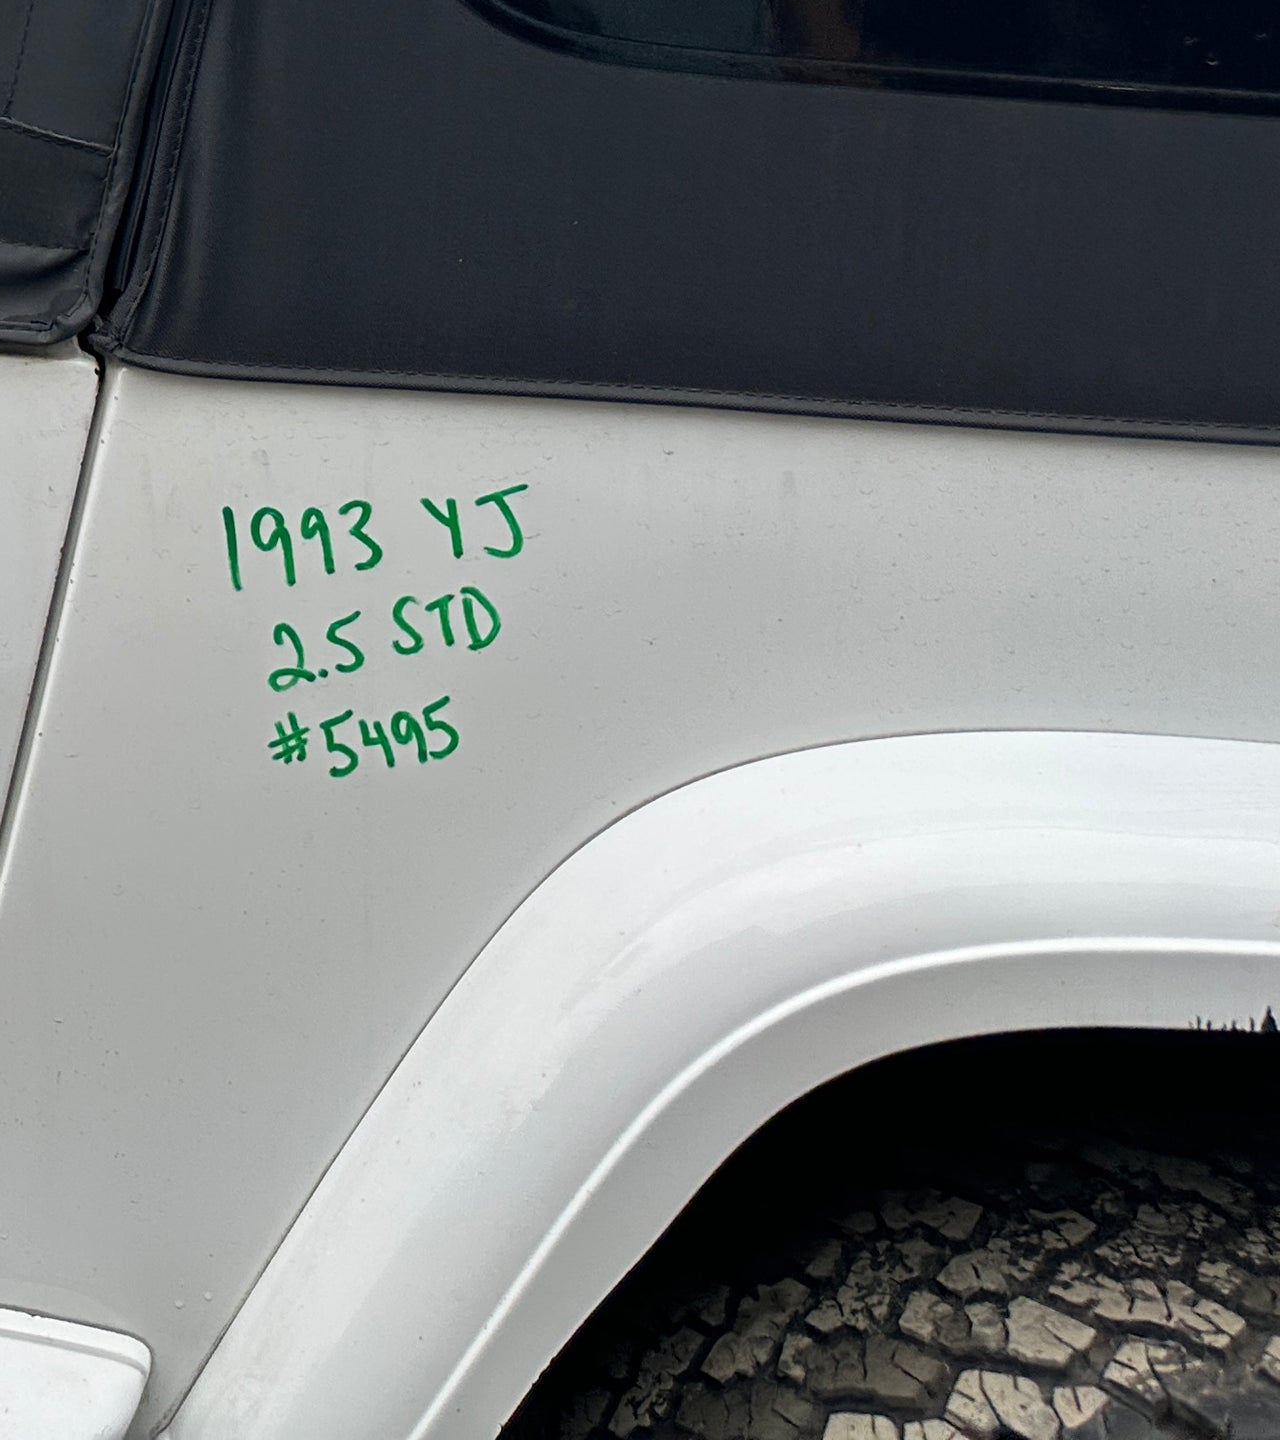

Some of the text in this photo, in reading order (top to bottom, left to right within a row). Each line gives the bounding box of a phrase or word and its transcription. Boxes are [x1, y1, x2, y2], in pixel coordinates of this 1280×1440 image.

[222, 483, 529, 591] 1993 YJ
[268, 586, 501, 692] 2.5 STD
[267, 695, 460, 778] #5495
